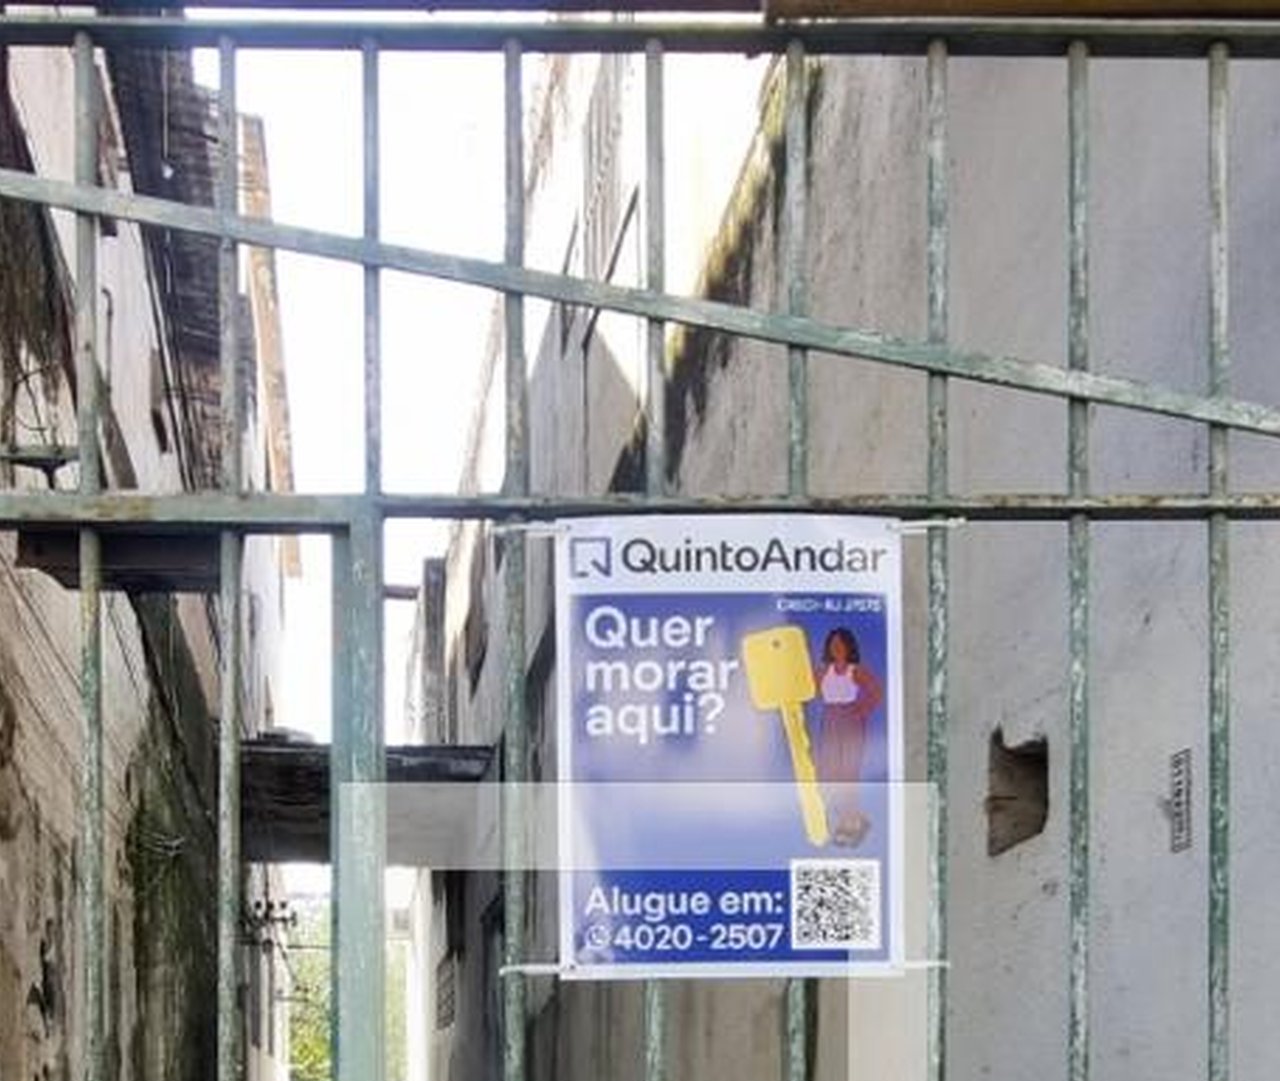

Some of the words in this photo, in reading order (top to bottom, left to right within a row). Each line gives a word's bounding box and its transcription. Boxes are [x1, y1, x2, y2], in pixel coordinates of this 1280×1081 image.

[621, 536, 886, 576] QuintoAndar
[584, 606, 714, 649] Quer
[585, 658, 738, 691] morar
[585, 694, 725, 744] aqui?
[585, 886, 708, 922] Alugue
[720, 891, 784, 915] em:
